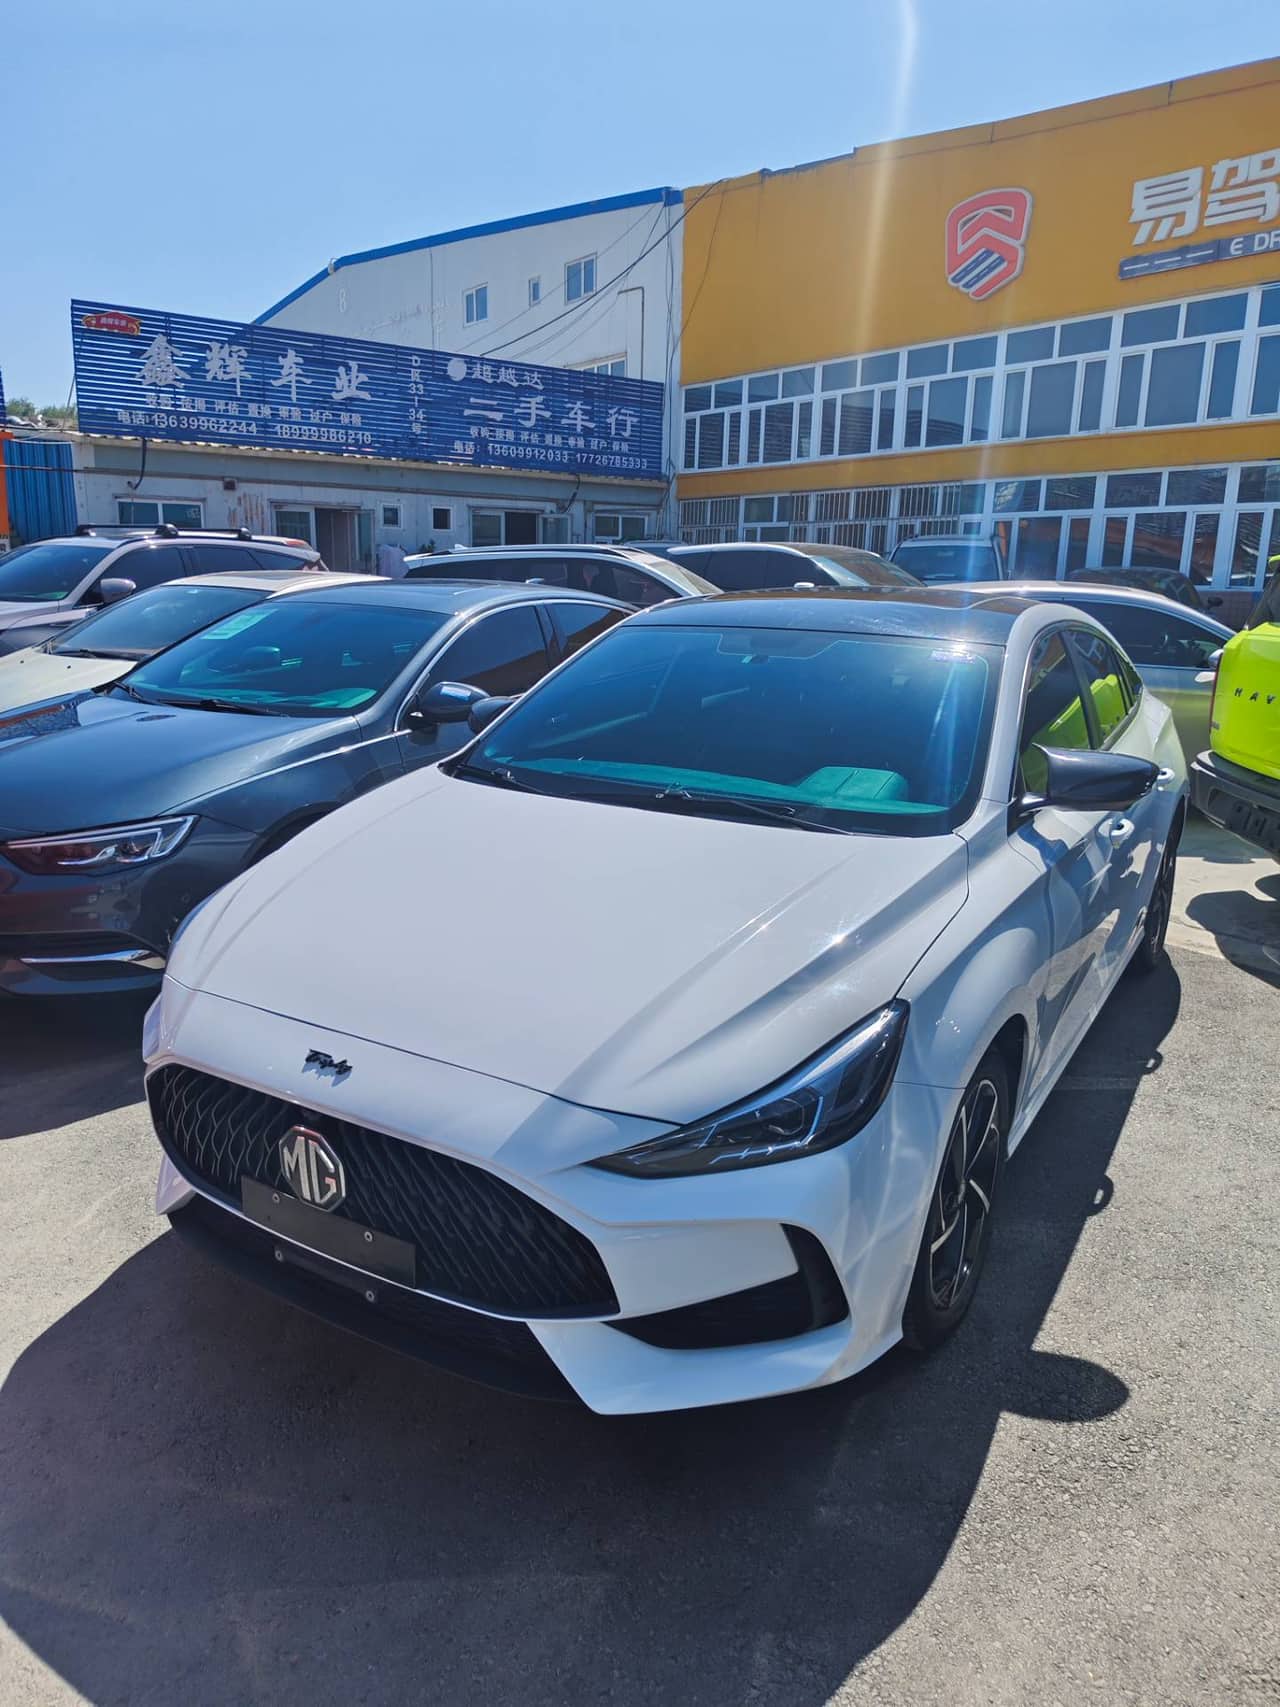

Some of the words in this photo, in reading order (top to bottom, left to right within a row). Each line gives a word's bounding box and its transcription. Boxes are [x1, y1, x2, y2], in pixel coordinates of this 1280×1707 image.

[1129, 148, 1280, 245] 易驾
[1230, 237, 1244, 255] E
[136, 333, 372, 402] 鑫辉车业
[471, 362, 545, 391] 超越达
[463, 396, 640, 438] 二手车行
[283, 1136, 337, 1204] MG
